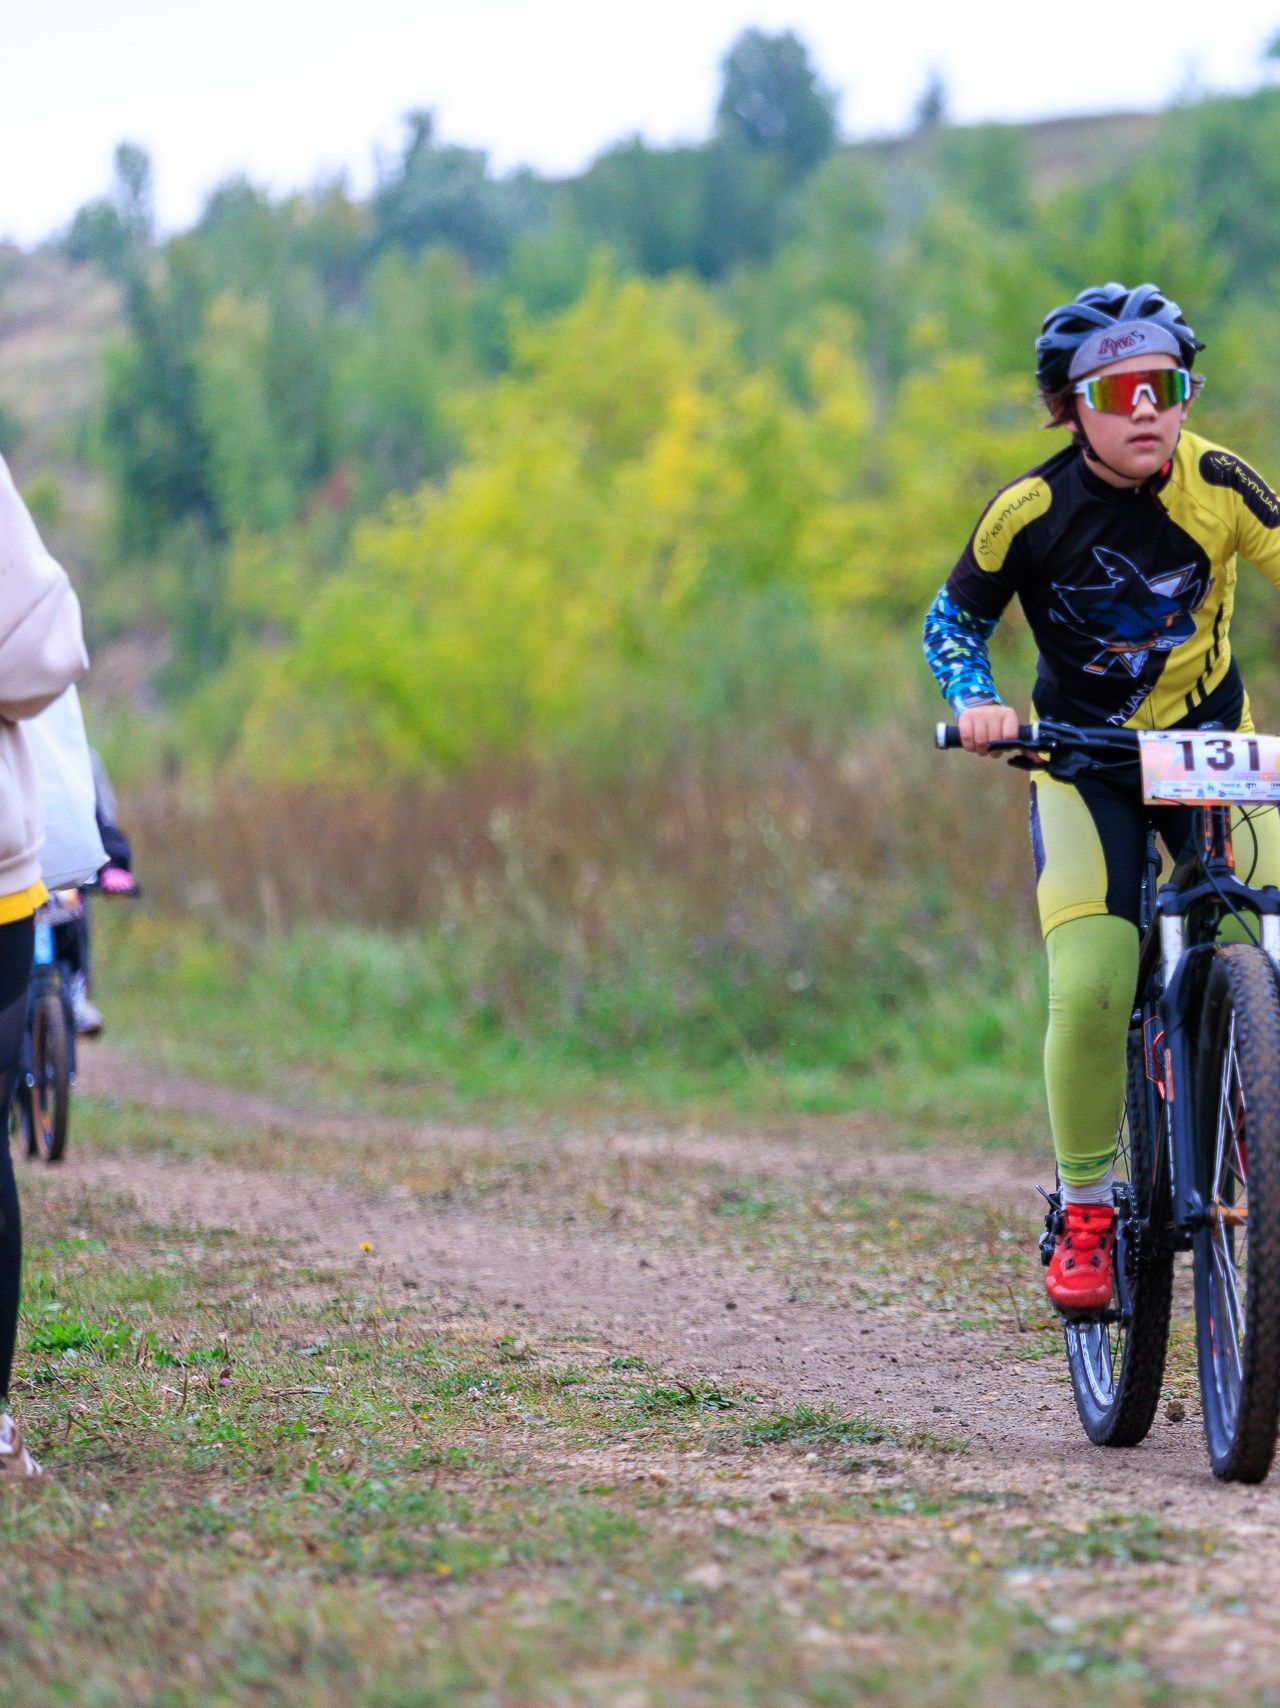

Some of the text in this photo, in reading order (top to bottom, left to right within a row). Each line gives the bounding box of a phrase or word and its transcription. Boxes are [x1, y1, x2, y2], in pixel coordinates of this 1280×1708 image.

[1235, 465, 1279, 515] KEYIYUAN
[990, 489, 1041, 538] KEYIYUAN
[1106, 683, 1153, 726] IYUAN
[1176, 739, 1261, 771] 131
